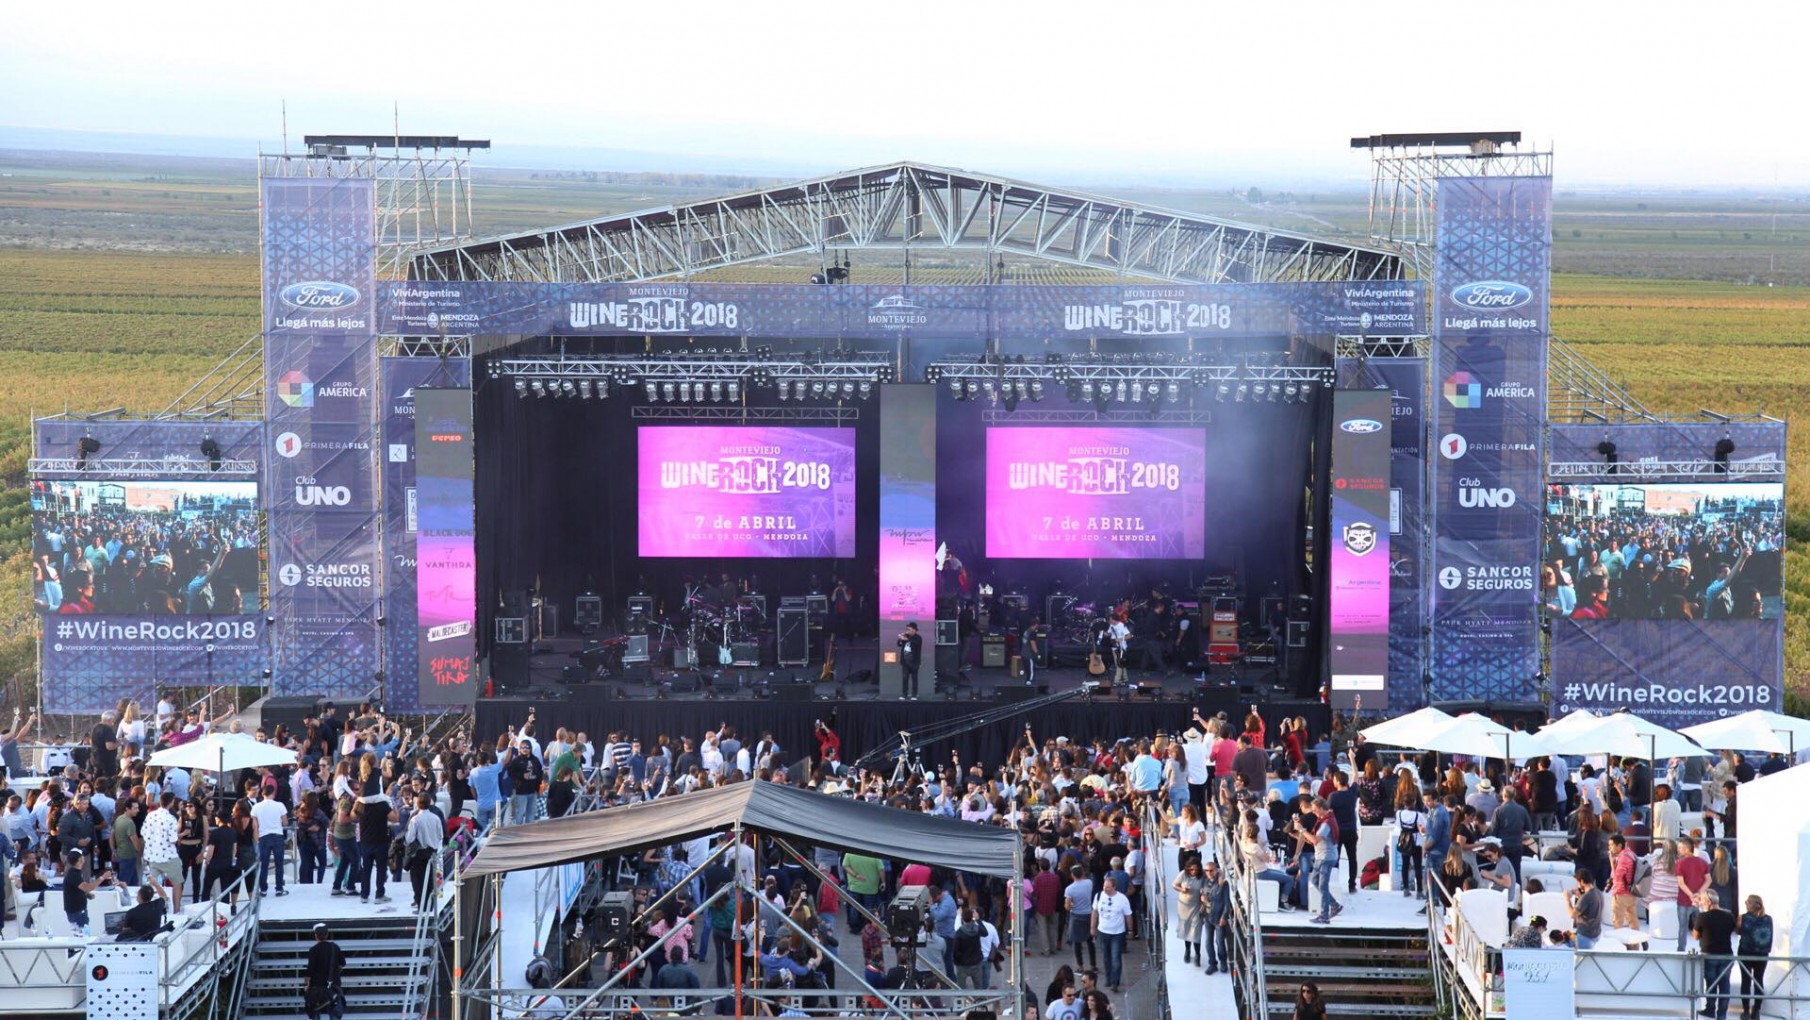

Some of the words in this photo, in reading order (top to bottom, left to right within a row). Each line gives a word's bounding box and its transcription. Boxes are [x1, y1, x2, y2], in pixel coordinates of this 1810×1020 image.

[296, 286, 344, 306] Ford
[1467, 286, 1516, 305] Ford
[276, 317, 307, 329] Llegá
[310, 318, 335, 328] más
[338, 318, 365, 329] lejos
[691, 302, 738, 329] 2018
[1186, 304, 1231, 329] 2018
[1445, 318, 1477, 329] Llegá
[1480, 318, 1506, 328] más
[1508, 318, 1536, 329] lejos
[296, 476, 316, 485] Club
[783, 462, 830, 490] 2018
[1131, 463, 1179, 490] 2018
[1459, 478, 1481, 486] Club
[295, 486, 351, 506] UNO
[1459, 488, 1516, 508] UNO
[695, 516, 704, 529] 7
[713, 516, 732, 529] de
[739, 516, 796, 529] ABRIL
[1043, 517, 1052, 530] 7
[1061, 517, 1079, 530] de
[1087, 517, 1144, 530] ABRIL
[306, 564, 370, 575] SANCOR
[1467, 567, 1532, 577] SANCOR
[306, 576, 371, 587] SEGUROS
[1467, 578, 1533, 590] SEGUROS
[57, 621, 256, 639] #WineRock2018
[1564, 682, 1770, 704] #WineRock2018
